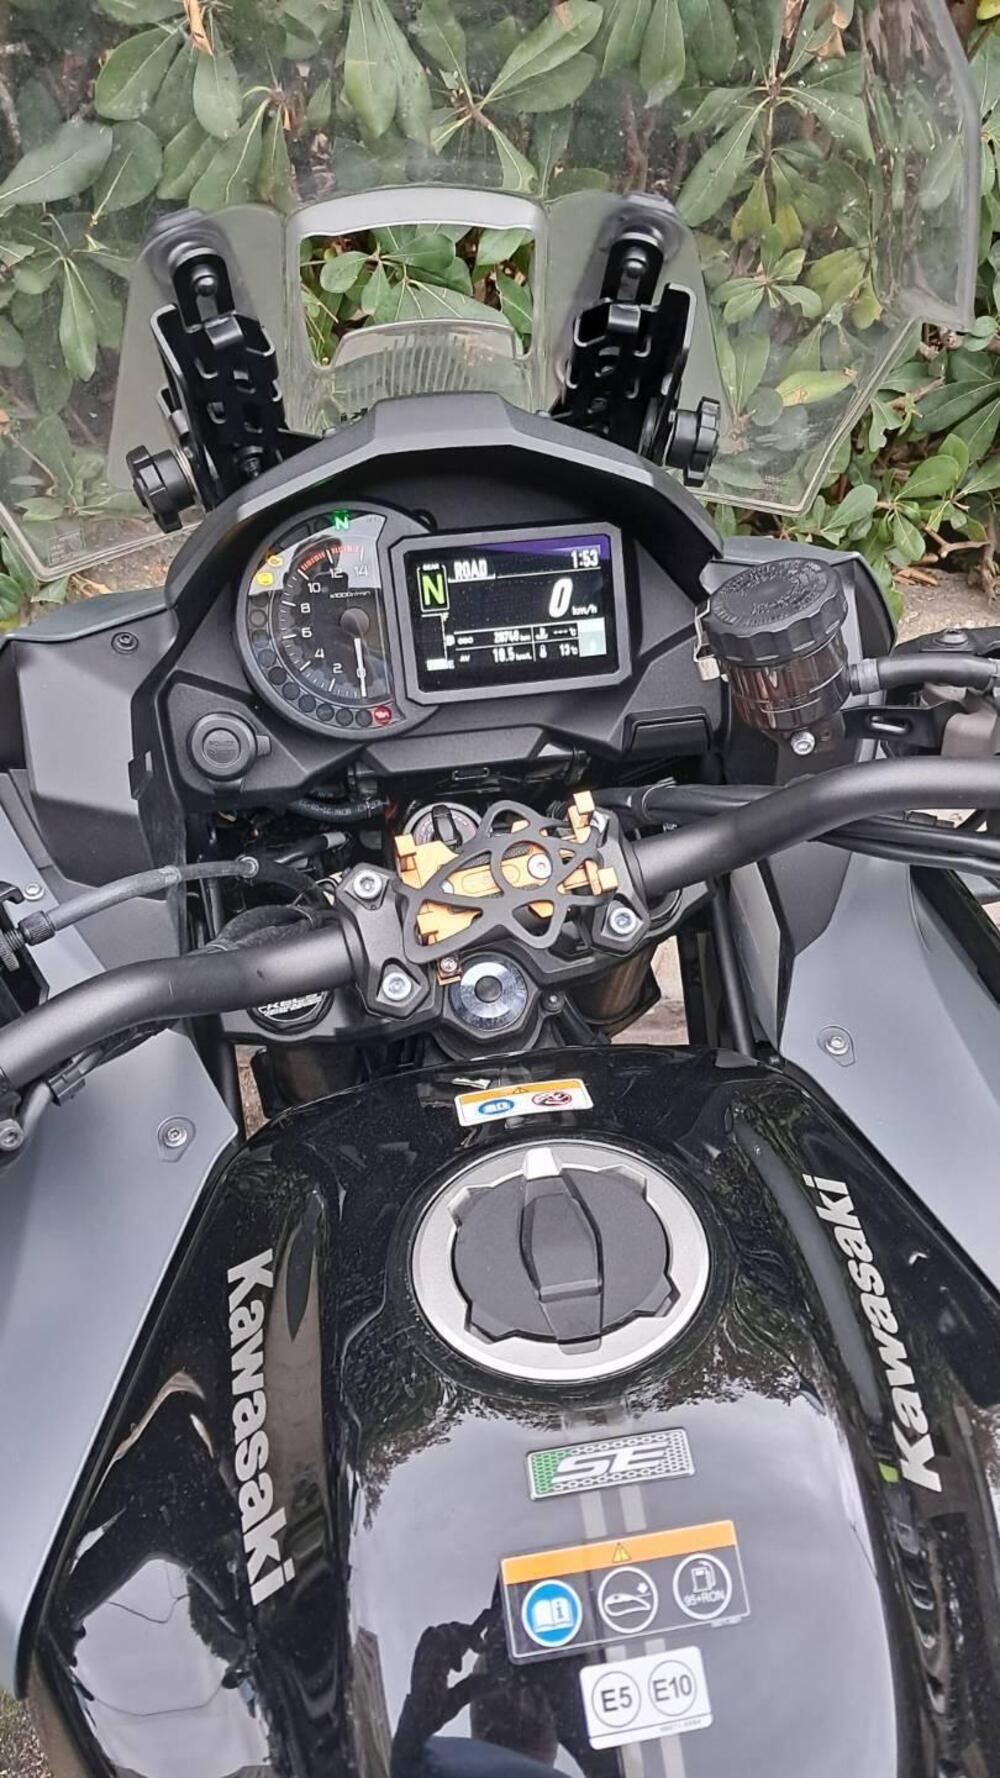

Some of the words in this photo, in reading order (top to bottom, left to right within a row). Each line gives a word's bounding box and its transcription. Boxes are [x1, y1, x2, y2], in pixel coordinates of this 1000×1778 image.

[334, 516, 350, 531] N
[571, 549, 598, 568] 1:53
[329, 567, 344, 579] 12
[354, 564, 369, 577] 14
[453, 559, 488, 580] ROAD
[307, 582, 321, 594] 10
[422, 573, 445, 606] N
[548, 577, 573, 618] 0
[300, 602, 311, 614] 8
[571, 604, 598, 616] km/h
[301, 627, 313, 638] 6
[314, 648, 325, 659] 4
[332, 662, 343, 674] 2
[802, 1173, 942, 1493] Kawasaki
[227, 1248, 296, 1607] Kawasaki
[551, 1441, 671, 1483] SE
[600, 1687, 633, 1713] E5
[653, 1674, 693, 1702] E10
